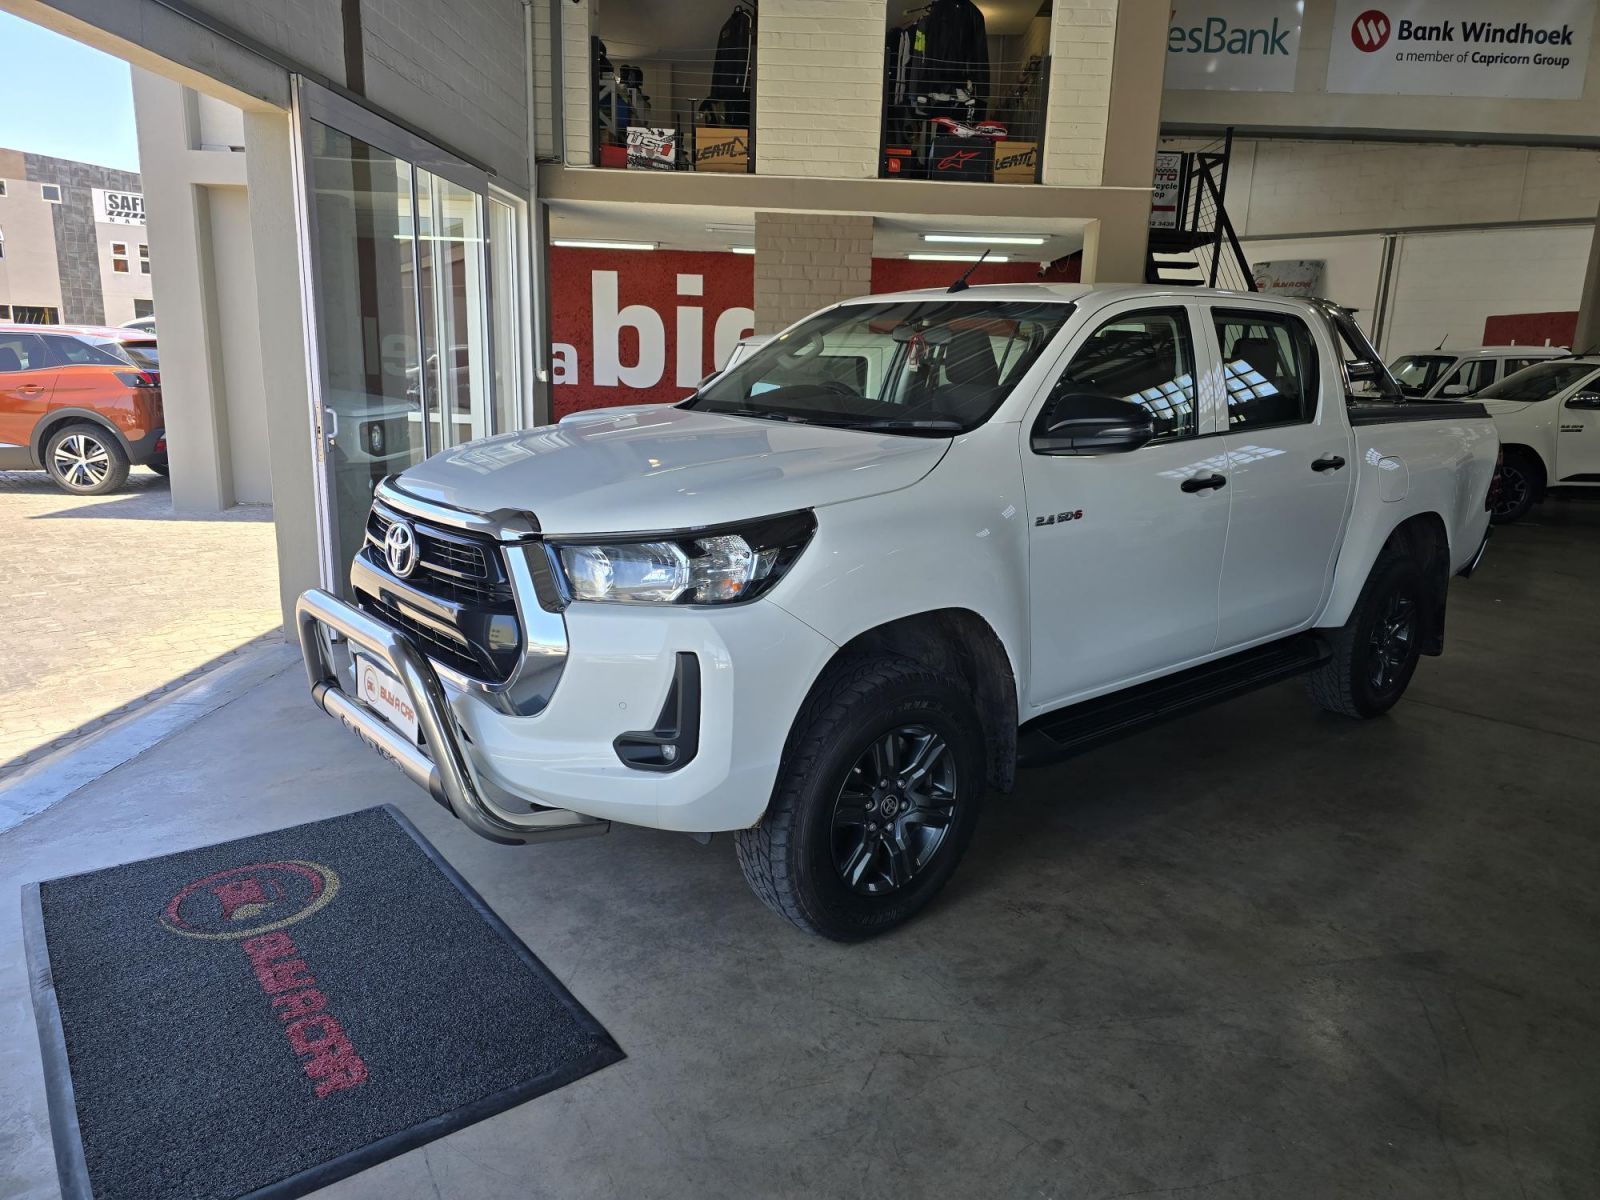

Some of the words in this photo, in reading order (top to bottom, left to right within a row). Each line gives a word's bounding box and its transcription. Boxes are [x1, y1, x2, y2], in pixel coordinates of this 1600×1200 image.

[1397, 19, 1454, 42] Bank
[1461, 21, 1574, 46] Windhoek
[1395, 51, 1403, 62] a
[1406, 51, 1453, 63] member
[1456, 51, 1470, 63] of
[1471, 51, 1530, 66] Capricorn
[1533, 53, 1570, 69] Group
[552, 342, 579, 385] a
[380, 686, 395, 706] BUY
[394, 697, 400, 711] A
[400, 702, 415, 723] CAR
[241, 930, 316, 994] BUY
[271, 988, 328, 1021] A
[285, 1013, 369, 1099] CAR
